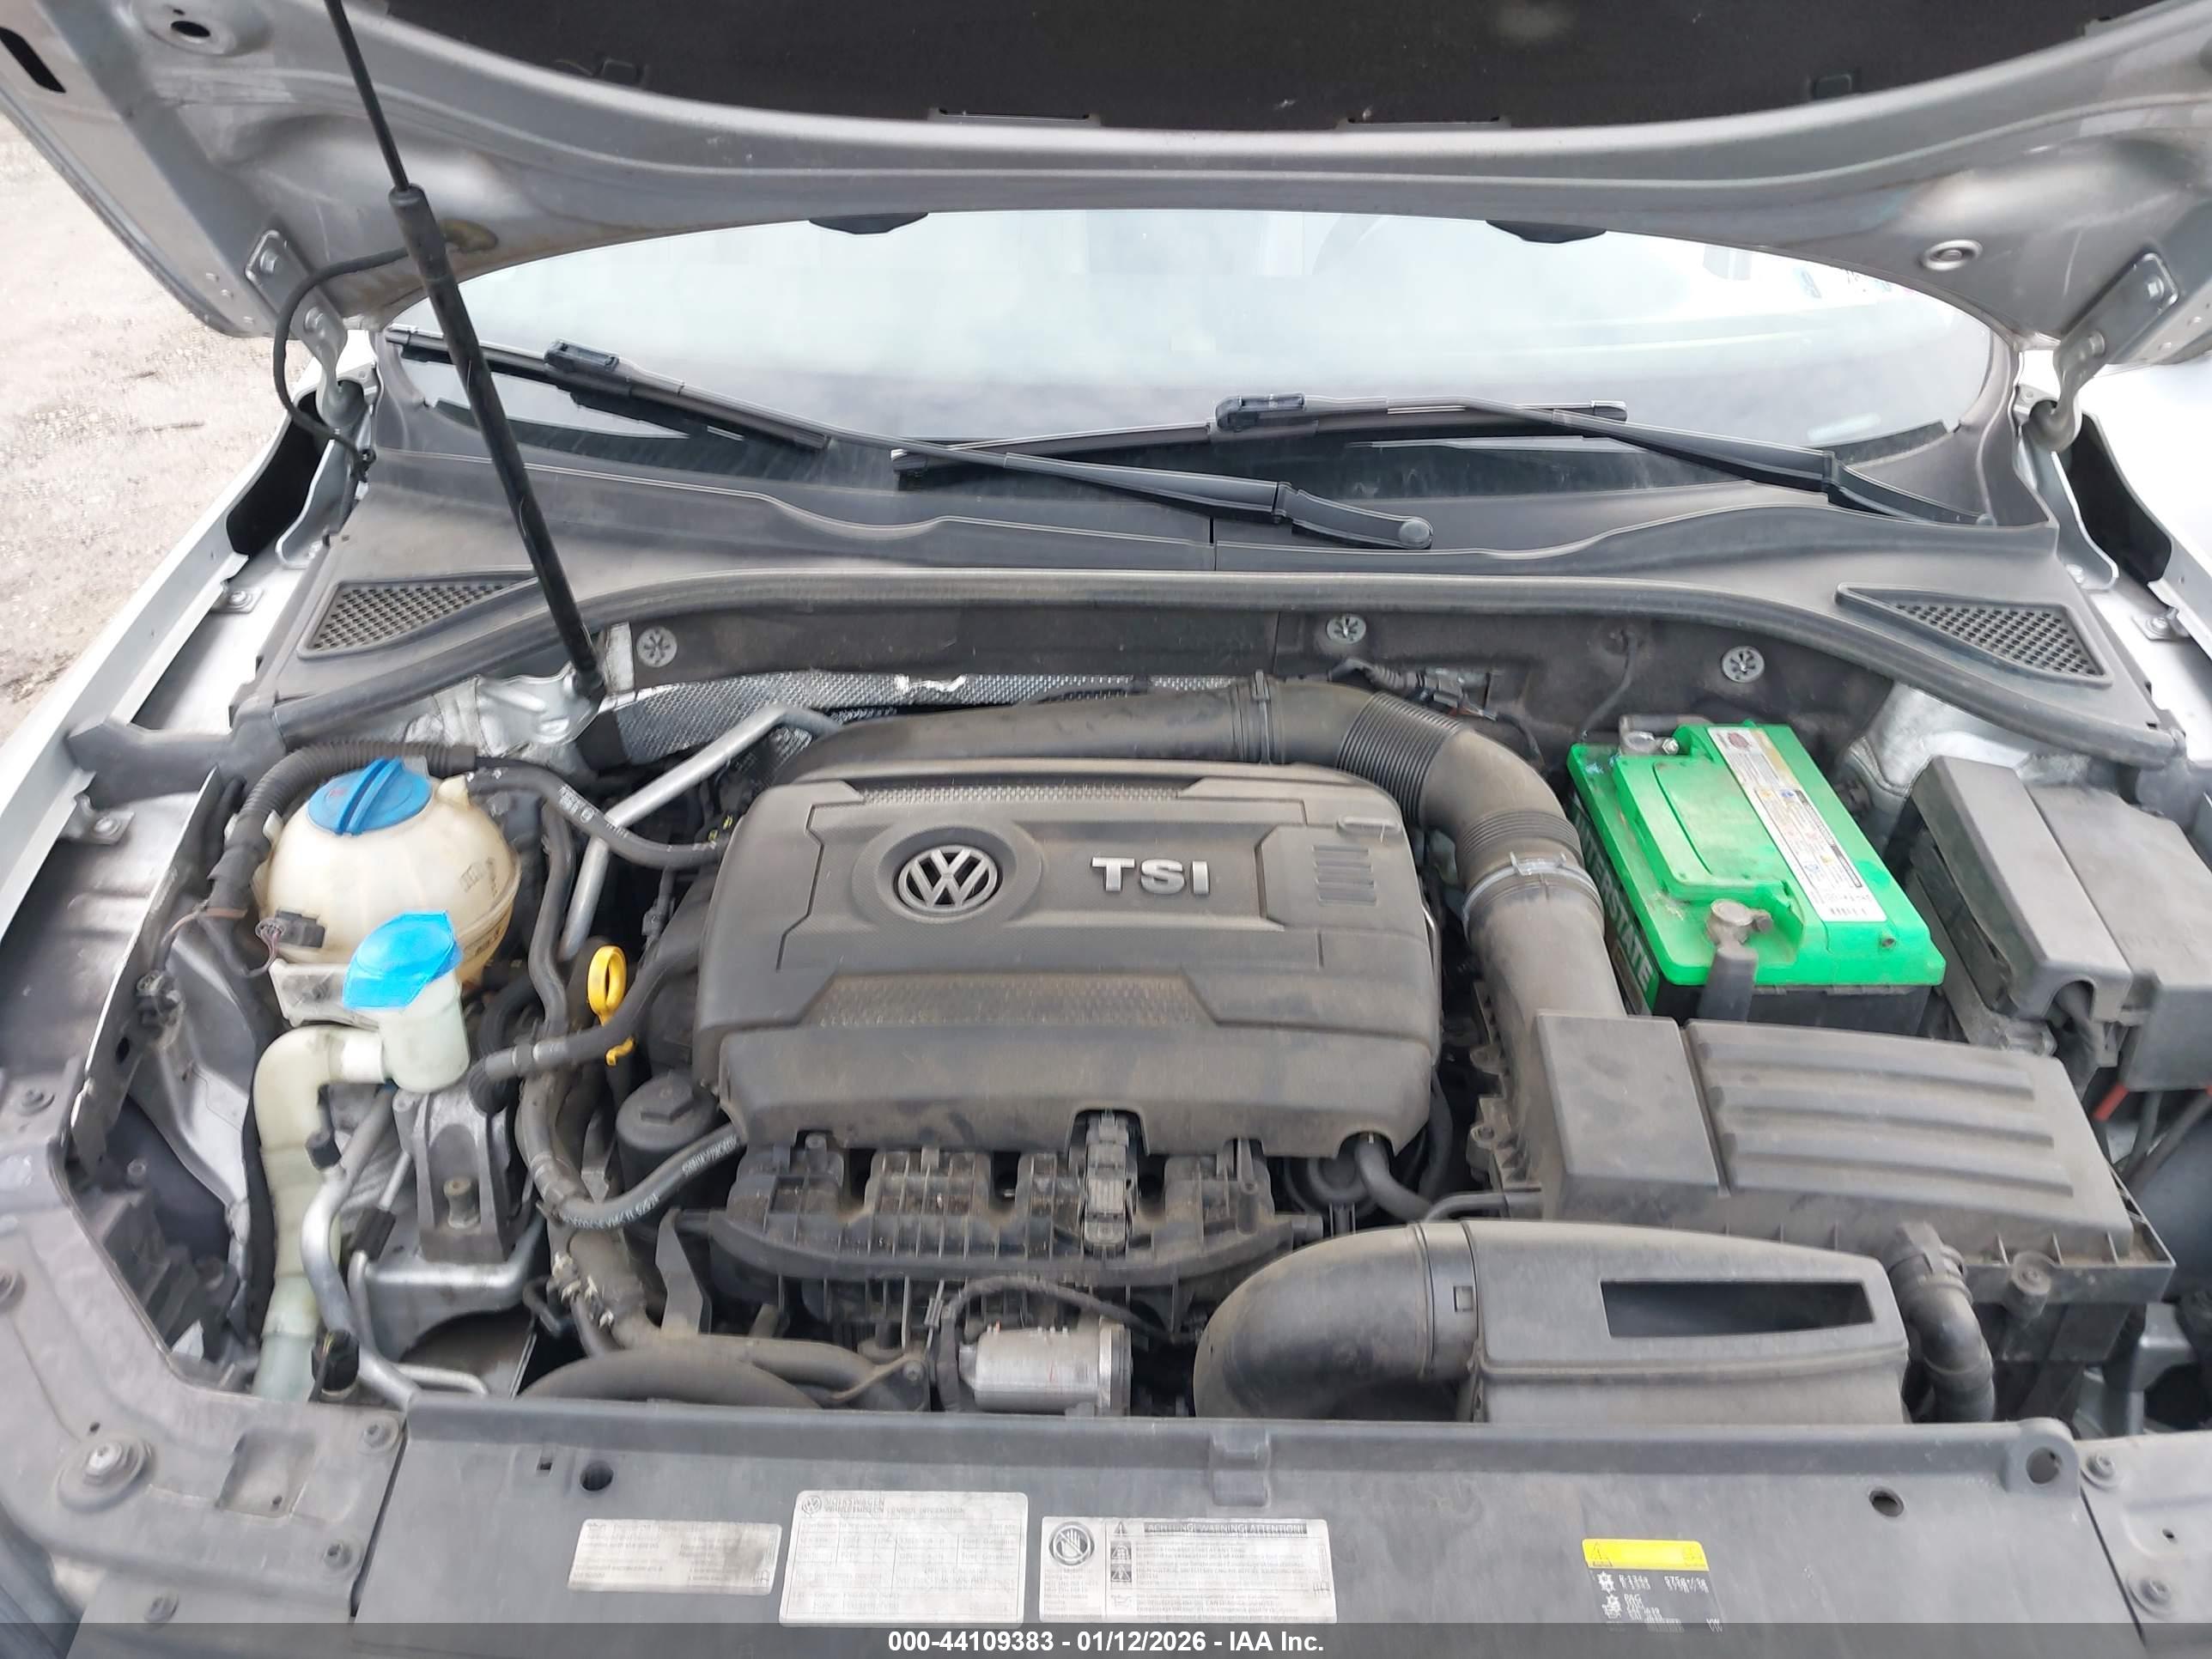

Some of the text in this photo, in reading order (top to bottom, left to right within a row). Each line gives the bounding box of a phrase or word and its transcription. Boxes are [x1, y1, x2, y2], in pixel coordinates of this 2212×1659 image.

[1091, 857, 1210, 895] TSI
[1200, 1523, 1247, 1534] WARNING!
[1249, 1524, 1306, 1534] ATTENTION!
